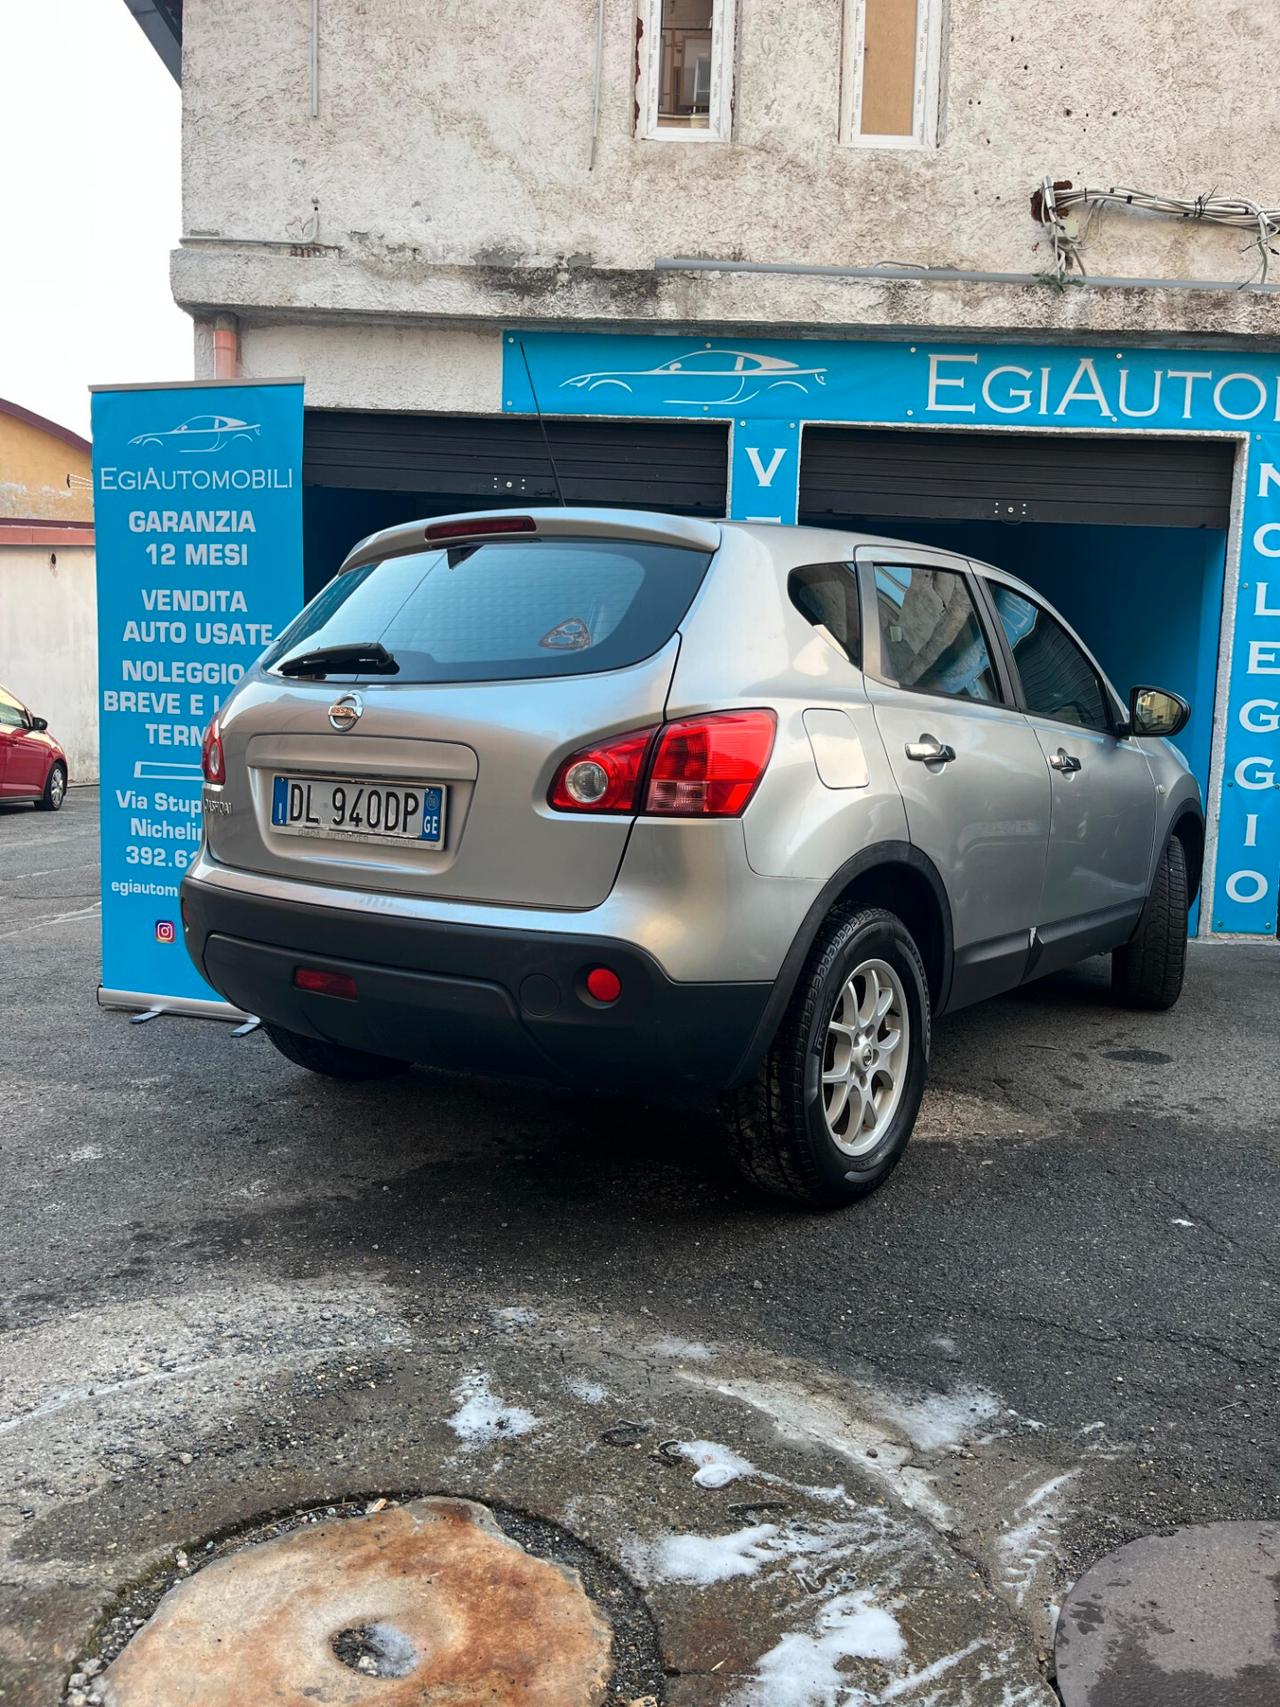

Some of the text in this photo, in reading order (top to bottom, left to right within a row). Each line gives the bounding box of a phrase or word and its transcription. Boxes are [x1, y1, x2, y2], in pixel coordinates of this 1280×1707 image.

[926, 353, 1280, 421] EGIAUTO
[128, 510, 256, 532] GARANZIA
[145, 543, 248, 566] 12 MESI
[141, 589, 248, 612] VENDITA
[122, 621, 273, 645] AUTO USATE
[122, 660, 244, 685] NOLEGGIO
[103, 690, 181, 715] BREVE
[190, 694, 204, 716] E
[115, 789, 148, 809] Via
[290, 784, 419, 832] DL 940DP
[424, 815, 438, 834] GE
